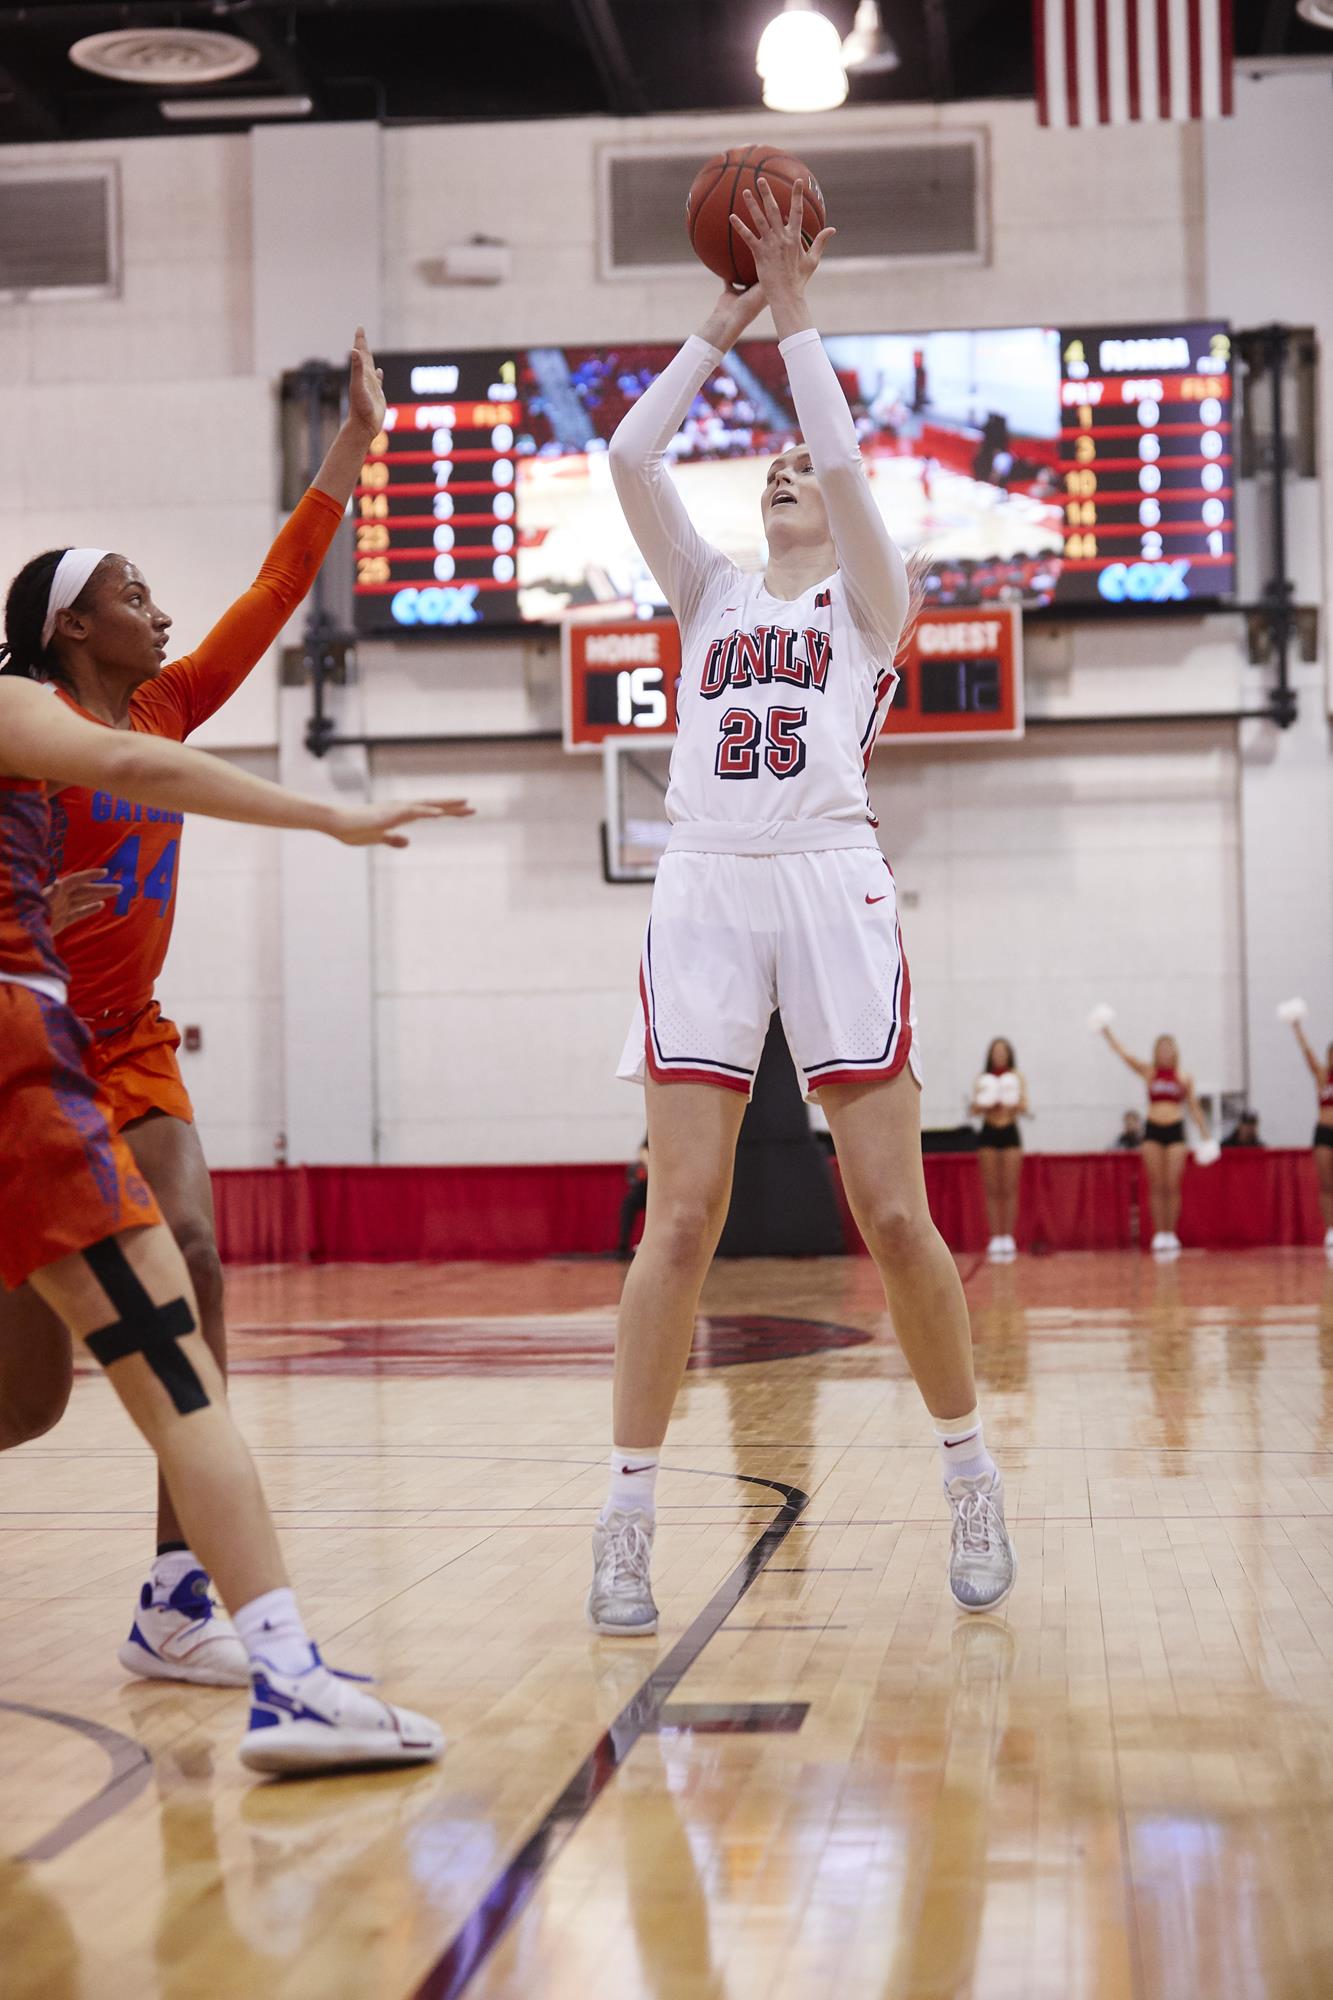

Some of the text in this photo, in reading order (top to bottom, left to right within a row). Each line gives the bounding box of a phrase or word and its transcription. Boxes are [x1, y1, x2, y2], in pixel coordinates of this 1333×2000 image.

[391, 584, 480, 625] COX
[1097, 559, 1192, 602] COX
[584, 633, 660, 665] HOME
[700, 625, 832, 700] UNLV
[917, 620, 1001, 655] GUEST
[617, 667, 667, 728] 15
[714, 706, 807, 780] 25
[92, 835, 178, 918] 44
